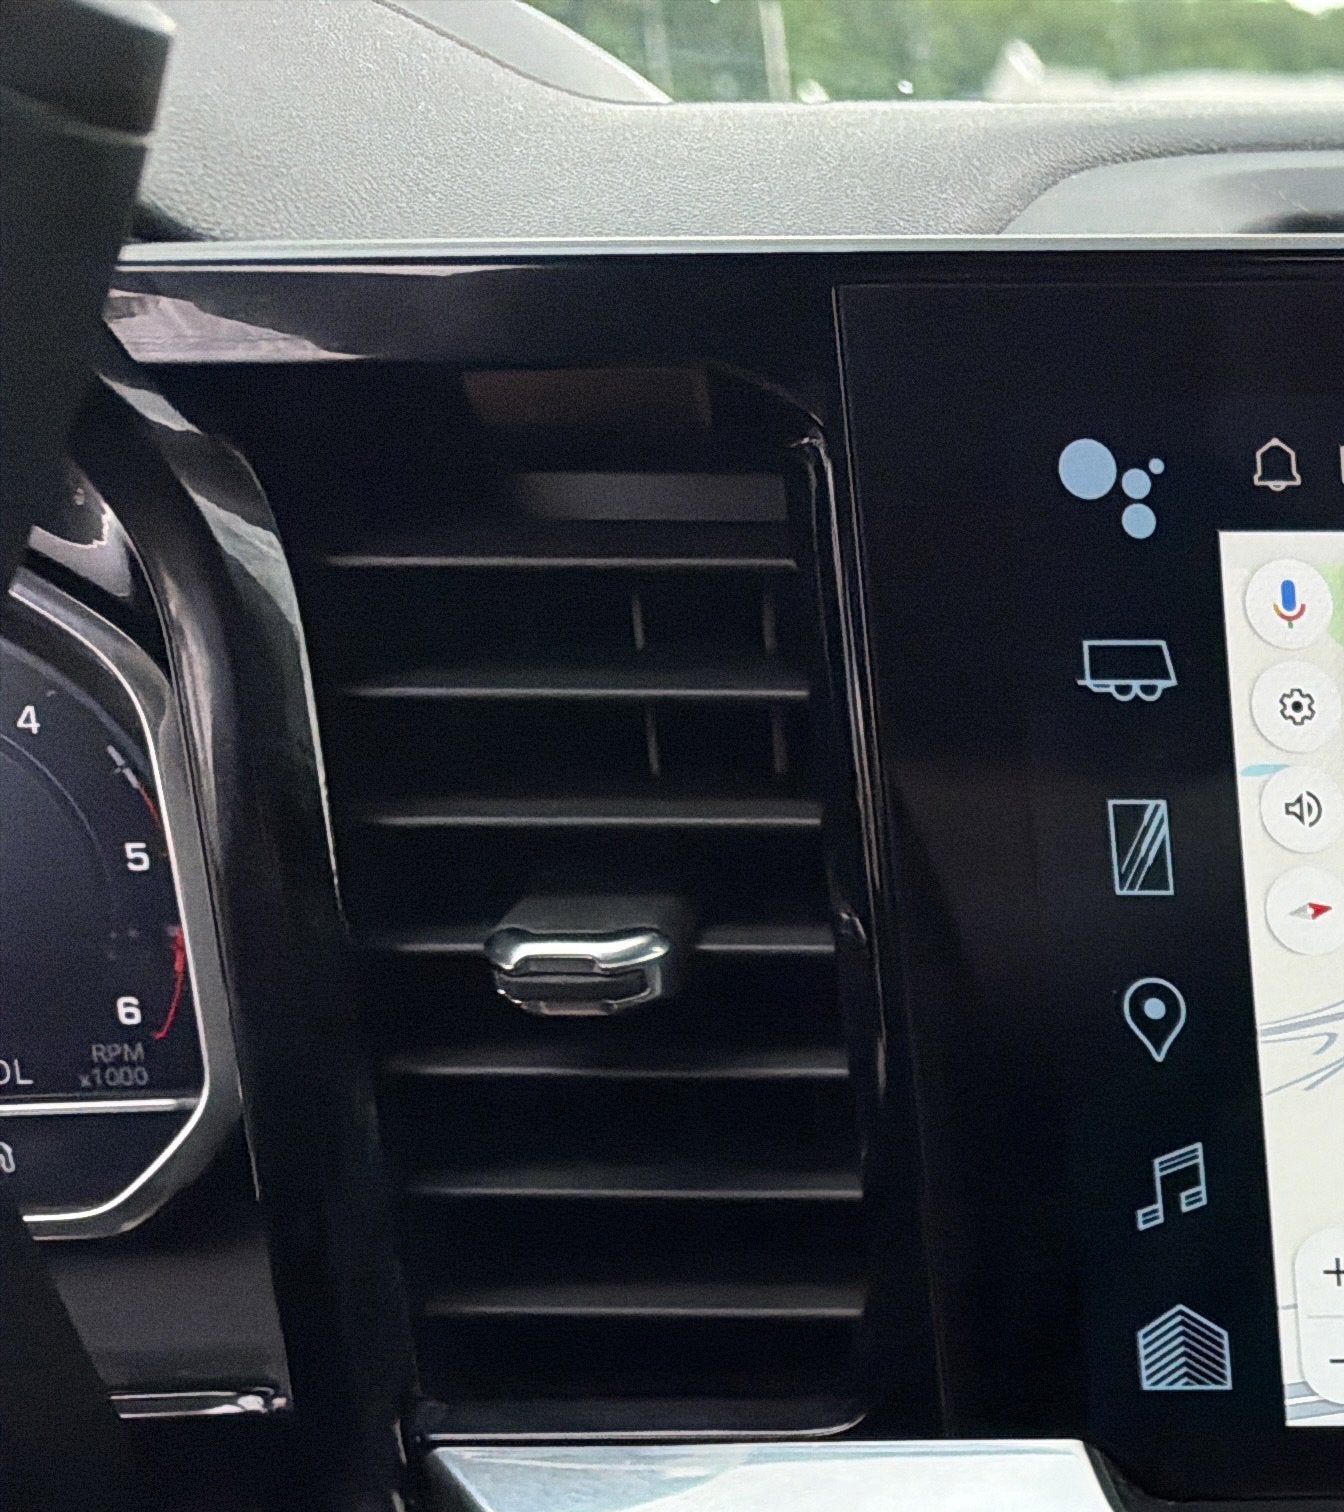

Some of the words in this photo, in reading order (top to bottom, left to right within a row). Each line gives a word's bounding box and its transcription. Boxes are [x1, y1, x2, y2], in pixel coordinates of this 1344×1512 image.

[16, 705, 41, 735] 4
[124, 842, 150, 872] 5
[116, 995, 142, 1026] 6
[91, 1042, 145, 1063] RPM
[80, 1066, 149, 1087] x1000
